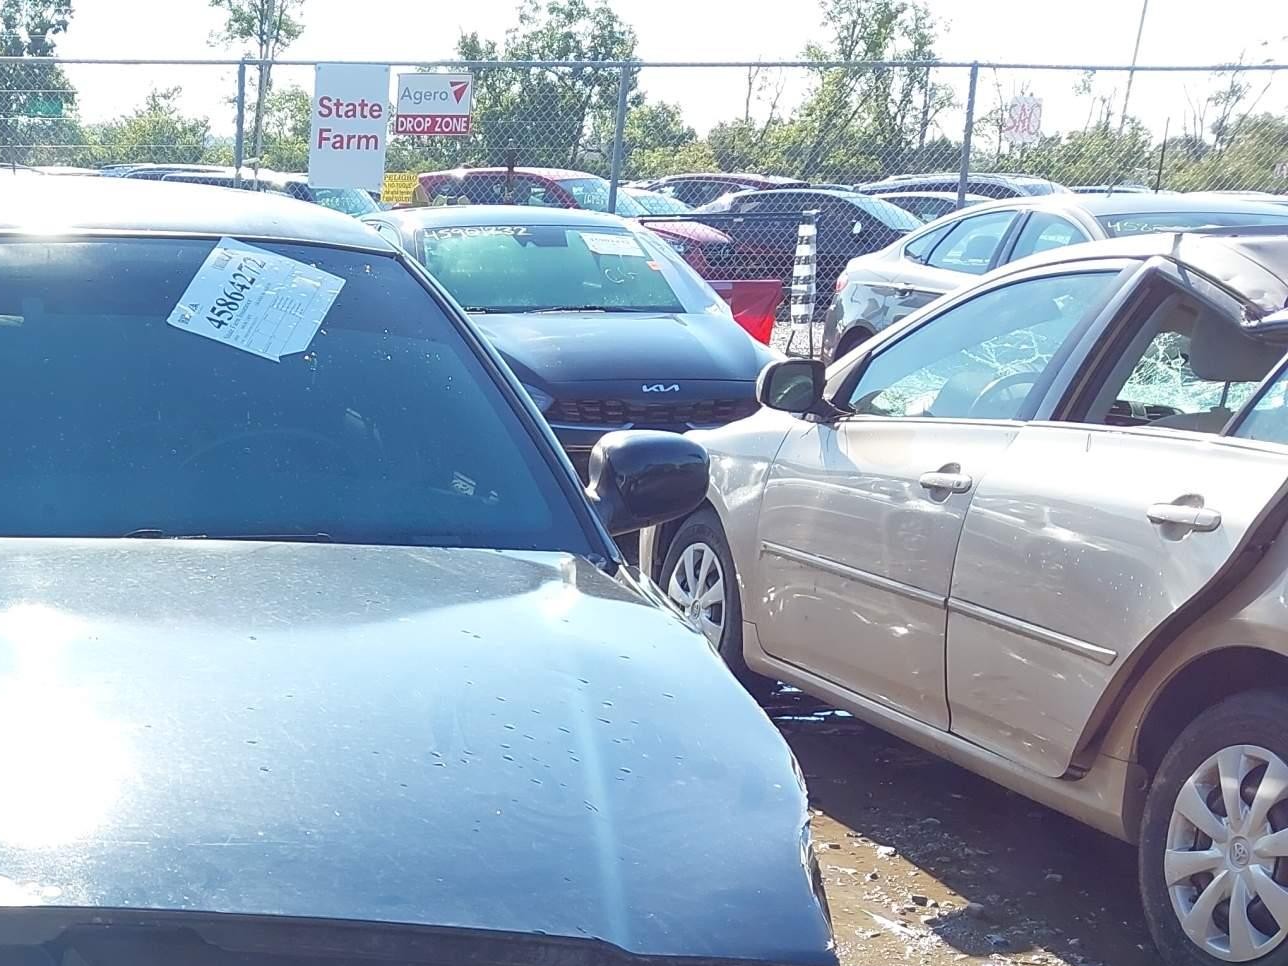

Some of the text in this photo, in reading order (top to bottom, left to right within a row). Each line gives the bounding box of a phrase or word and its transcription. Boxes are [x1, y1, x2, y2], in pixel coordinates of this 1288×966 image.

[401, 87, 449, 105] Agero
[318, 96, 383, 119] State
[398, 117, 468, 132] DROP ZONE
[318, 128, 379, 150] Farm
[205, 256, 266, 331] 45864272
